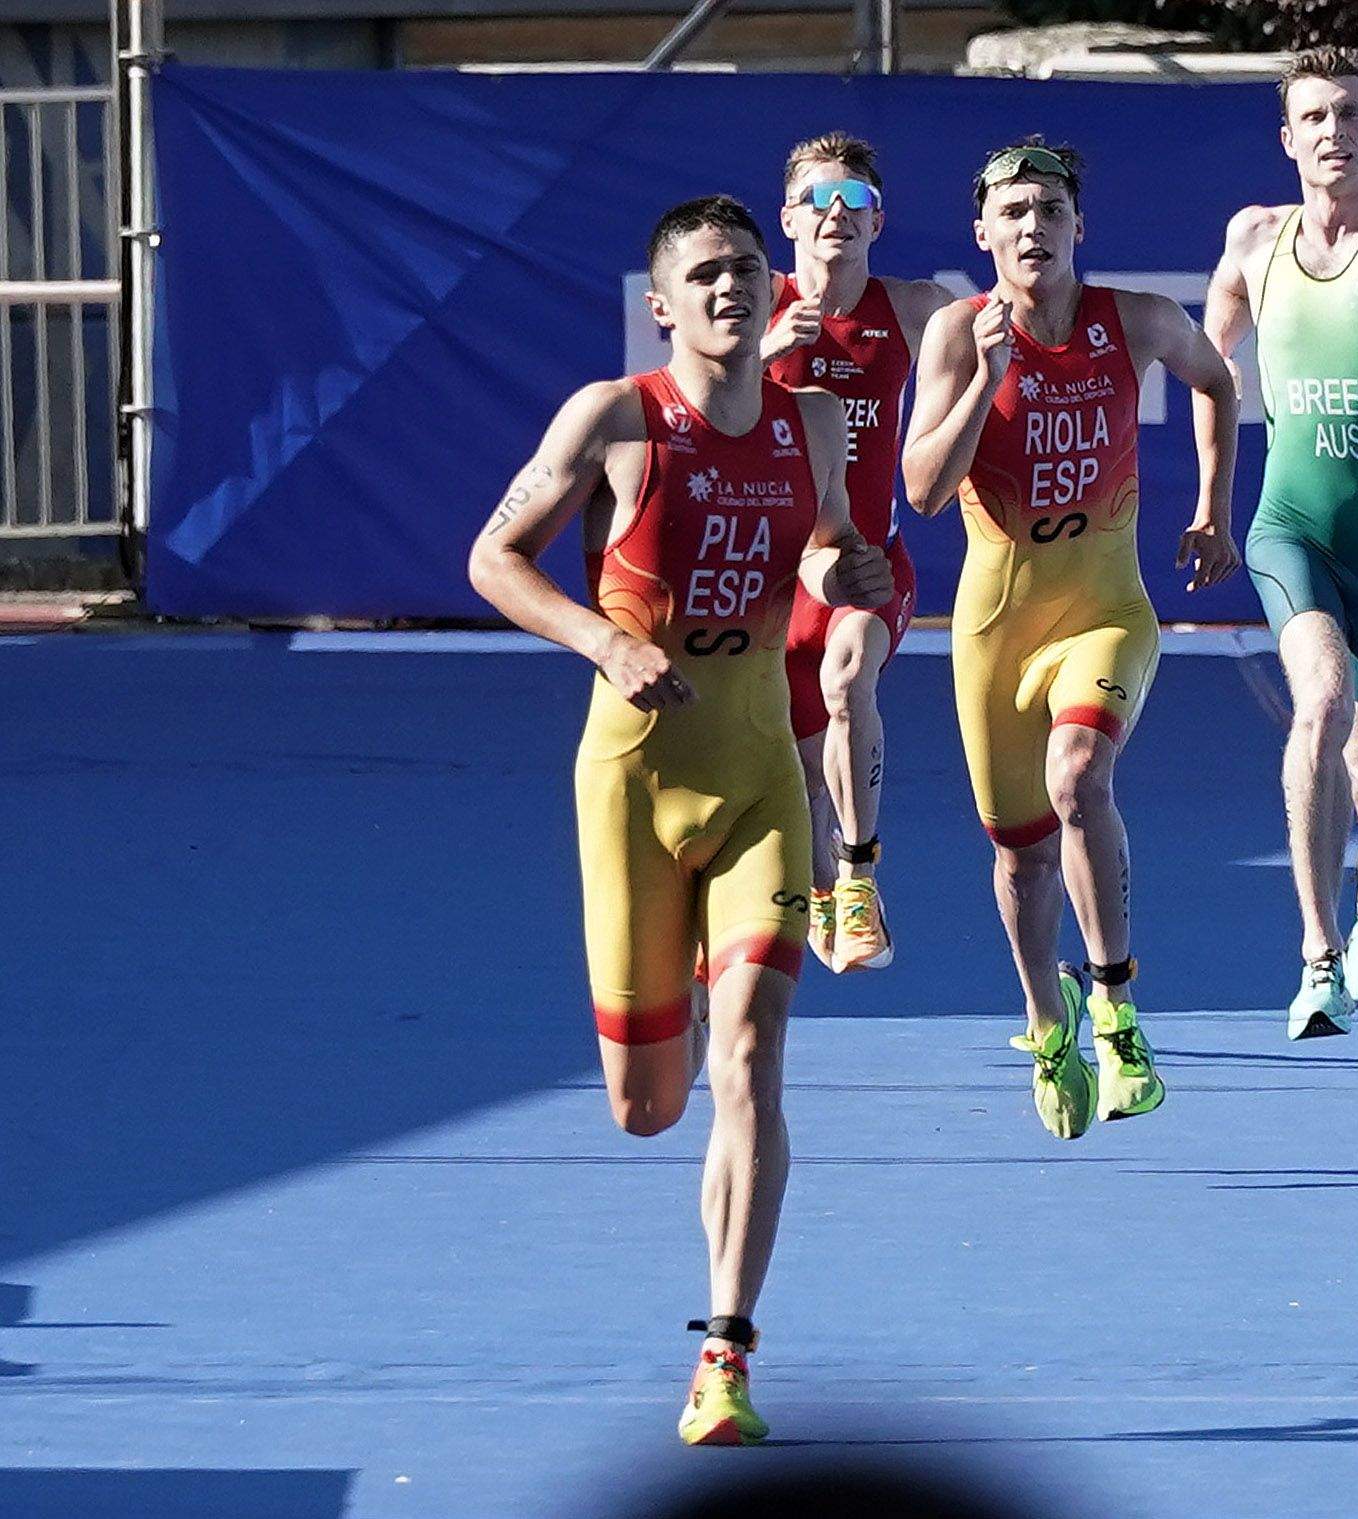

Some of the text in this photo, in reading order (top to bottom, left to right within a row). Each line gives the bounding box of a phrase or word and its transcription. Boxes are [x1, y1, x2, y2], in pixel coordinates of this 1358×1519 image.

[1024, 405, 1110, 456] RIOLA
[1030, 457, 1099, 508] ESP
[697, 514, 771, 563] PLA
[684, 569, 764, 618] ESP
